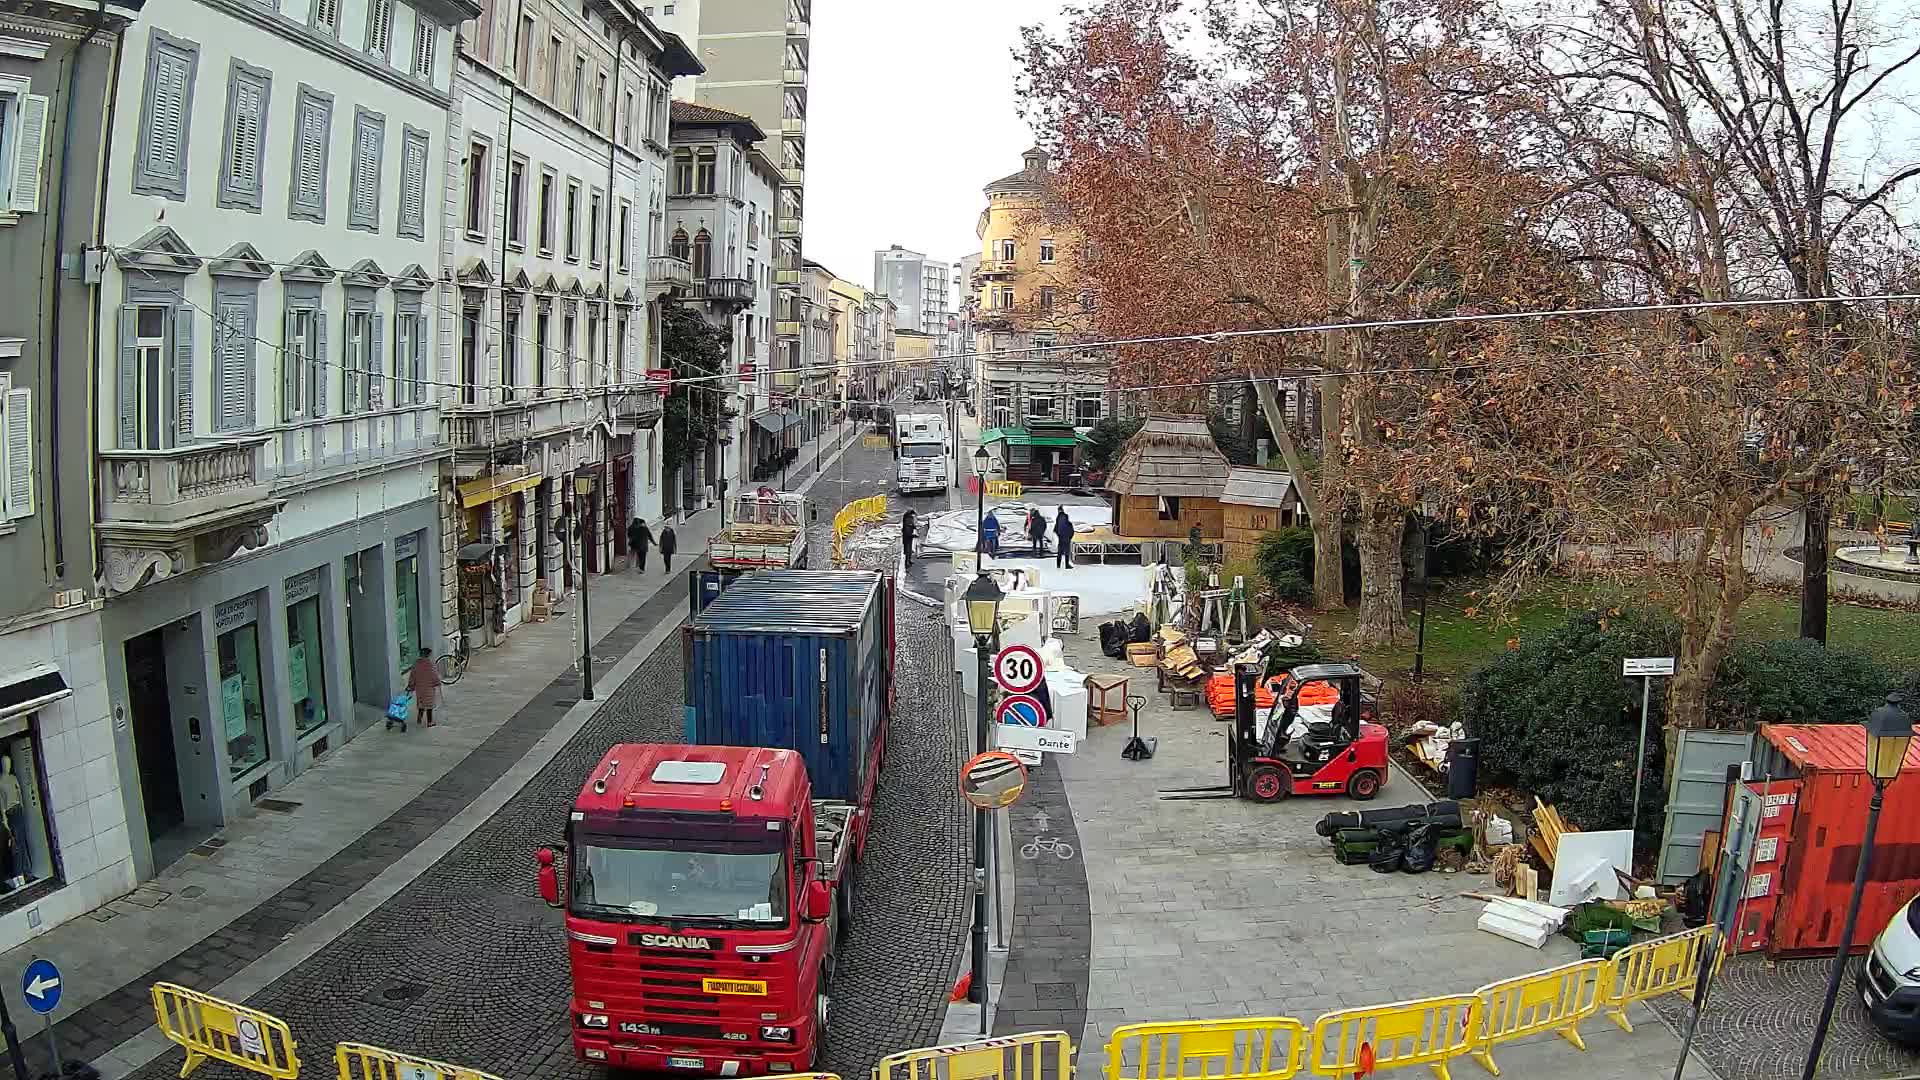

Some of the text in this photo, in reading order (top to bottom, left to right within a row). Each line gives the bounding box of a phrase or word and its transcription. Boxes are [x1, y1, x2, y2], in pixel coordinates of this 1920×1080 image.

[1006, 658, 1033, 680] 30
[1039, 737, 1069, 748] Dante
[640, 934, 710, 949] SCANIA
[722, 1032, 748, 1040] 420
